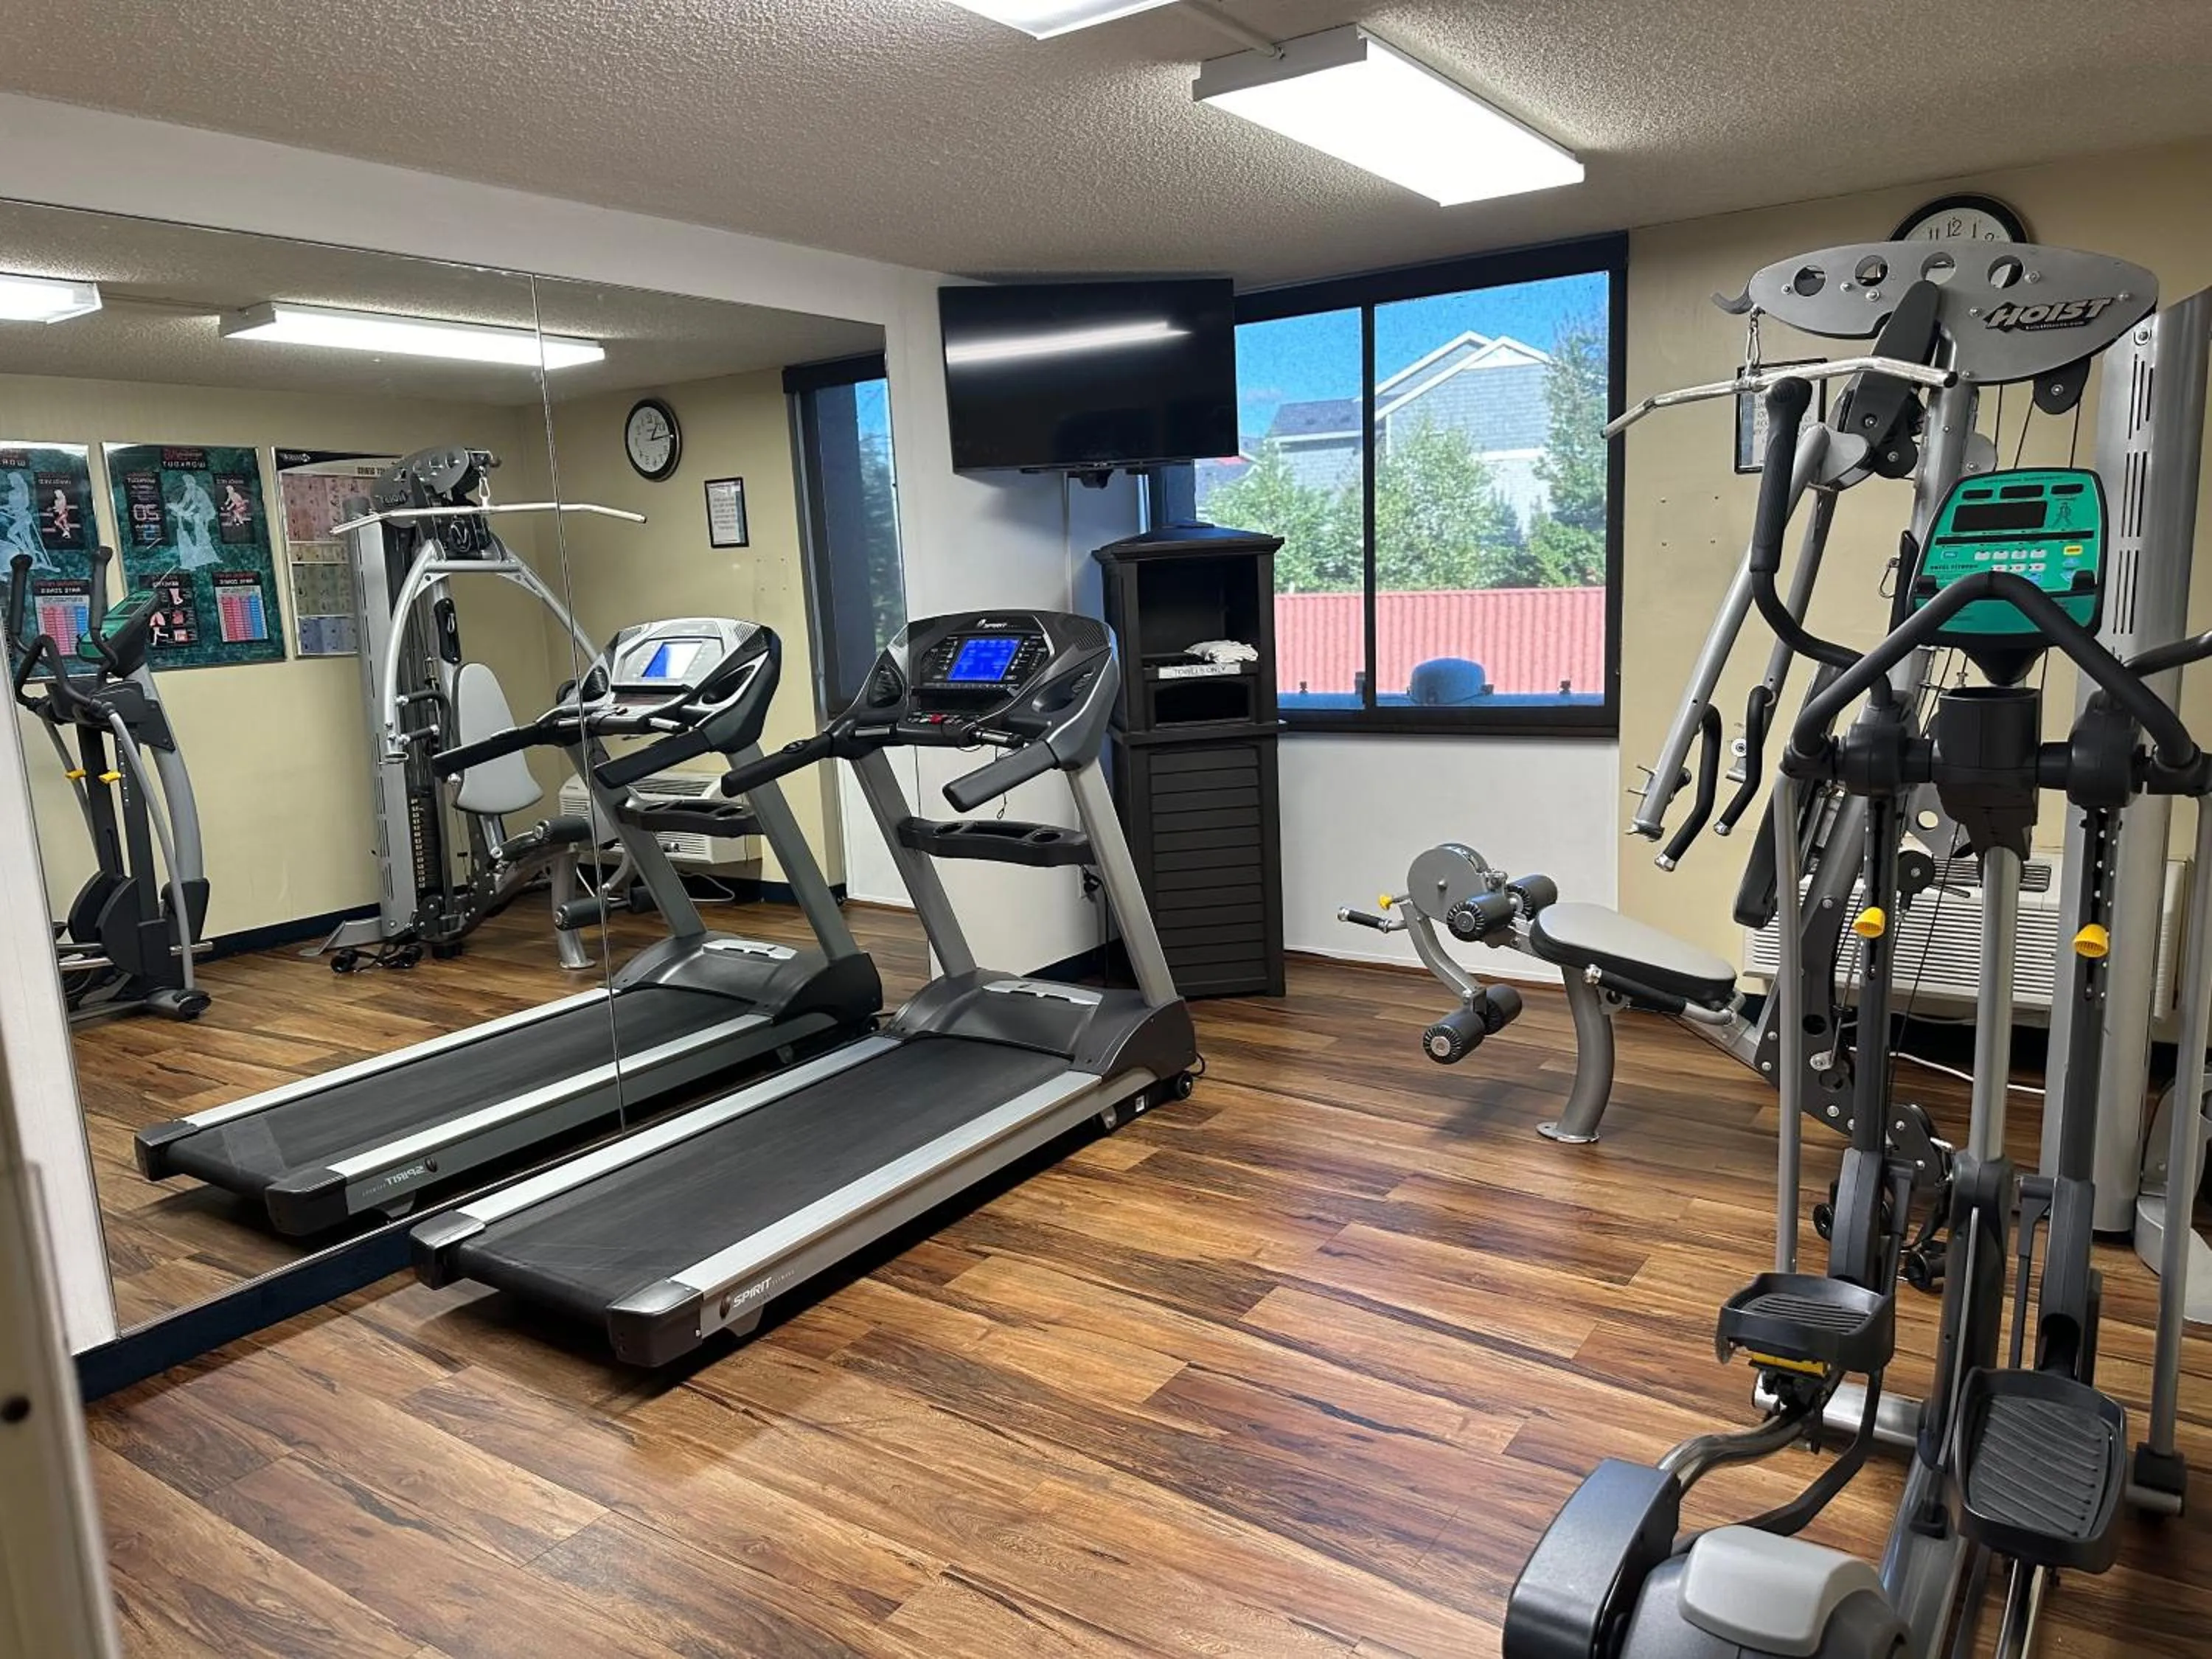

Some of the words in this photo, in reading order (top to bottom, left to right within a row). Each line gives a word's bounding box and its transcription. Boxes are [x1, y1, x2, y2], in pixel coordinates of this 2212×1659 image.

[1947, 219, 1962, 237] 12
[1987, 297, 2114, 327] HOIST
[732, 1276, 773, 1308] SPIRIT
